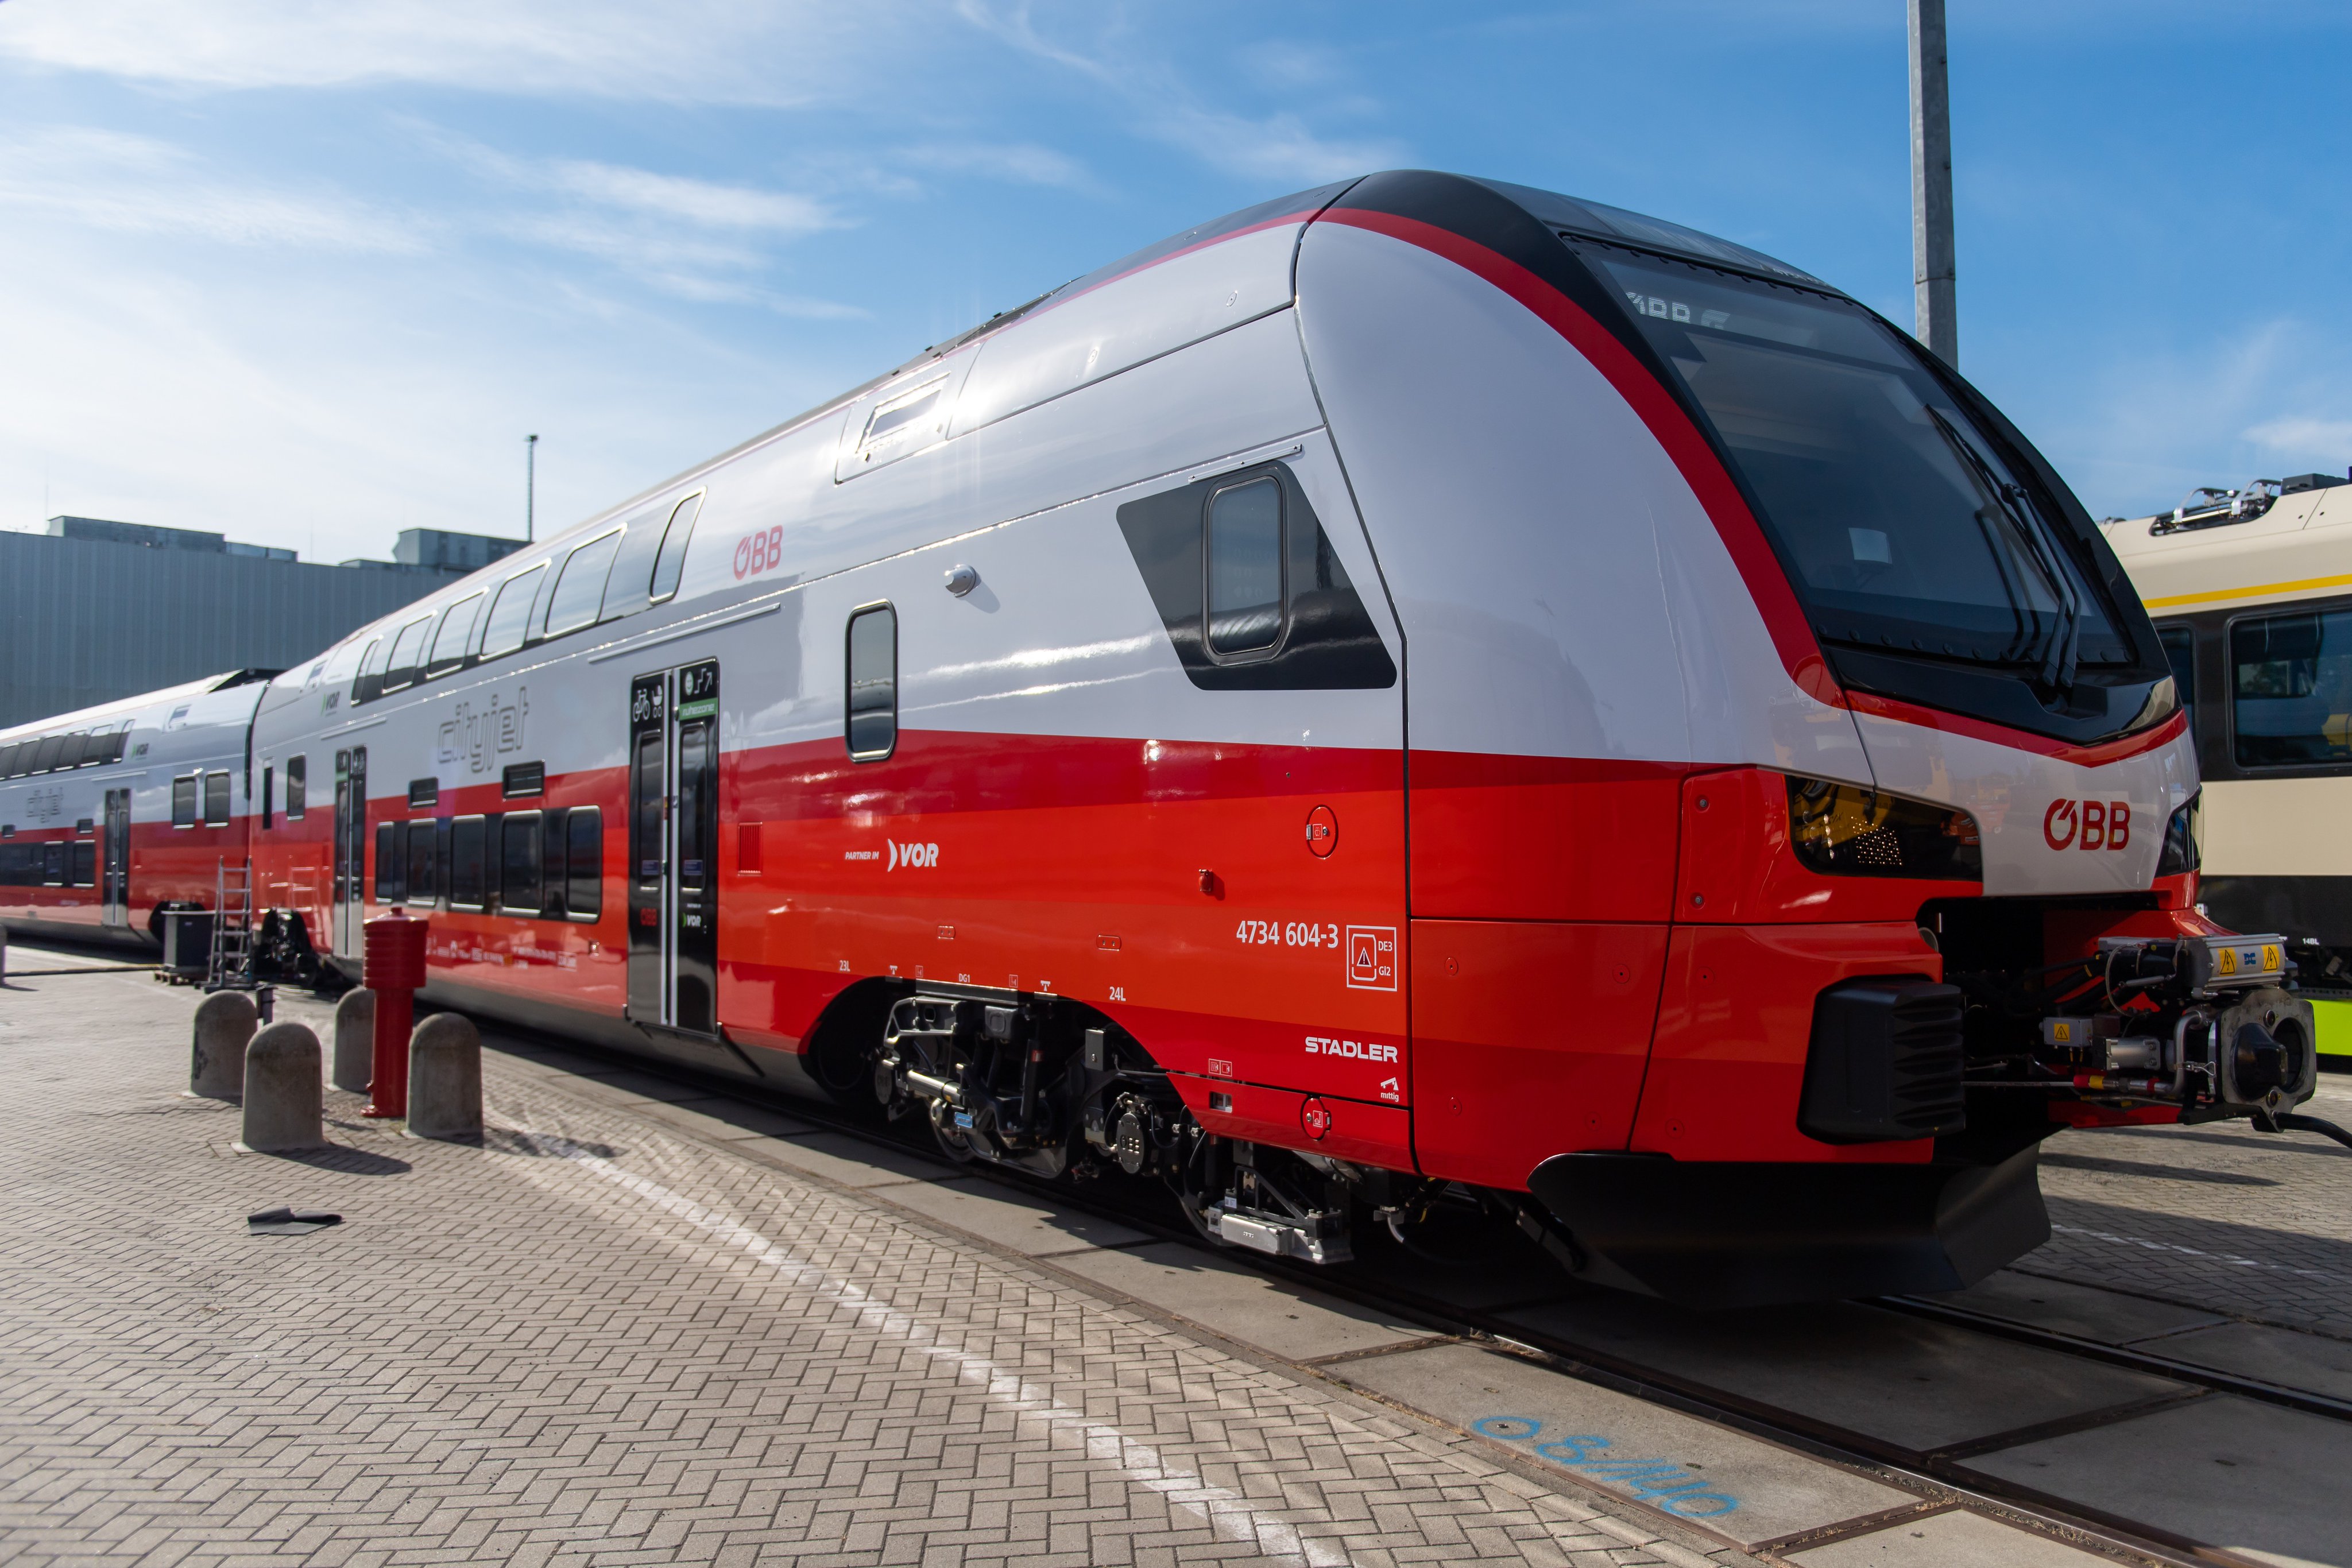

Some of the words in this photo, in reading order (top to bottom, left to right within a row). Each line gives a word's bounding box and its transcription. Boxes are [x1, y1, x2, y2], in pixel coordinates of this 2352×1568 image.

[733, 525, 783, 580] ÖBB
[683, 703, 715, 716] ruhezone
[439, 686, 529, 773] cityjet
[2044, 798, 2130, 851] ÖBB
[845, 851, 871, 860] PARTNER
[872, 851, 879, 860] IM
[899, 843, 939, 868] VOR
[687, 915, 702, 927] VOR
[1236, 920, 1280, 944] 4734
[1286, 922, 1339, 948] 604-3
[1378, 940, 1392, 951] DE3
[840, 960, 850, 971] 23L
[959, 973, 970, 983] DG1
[1109, 986, 1126, 1001] 24L
[1305, 1036, 1398, 1063] STADLER
